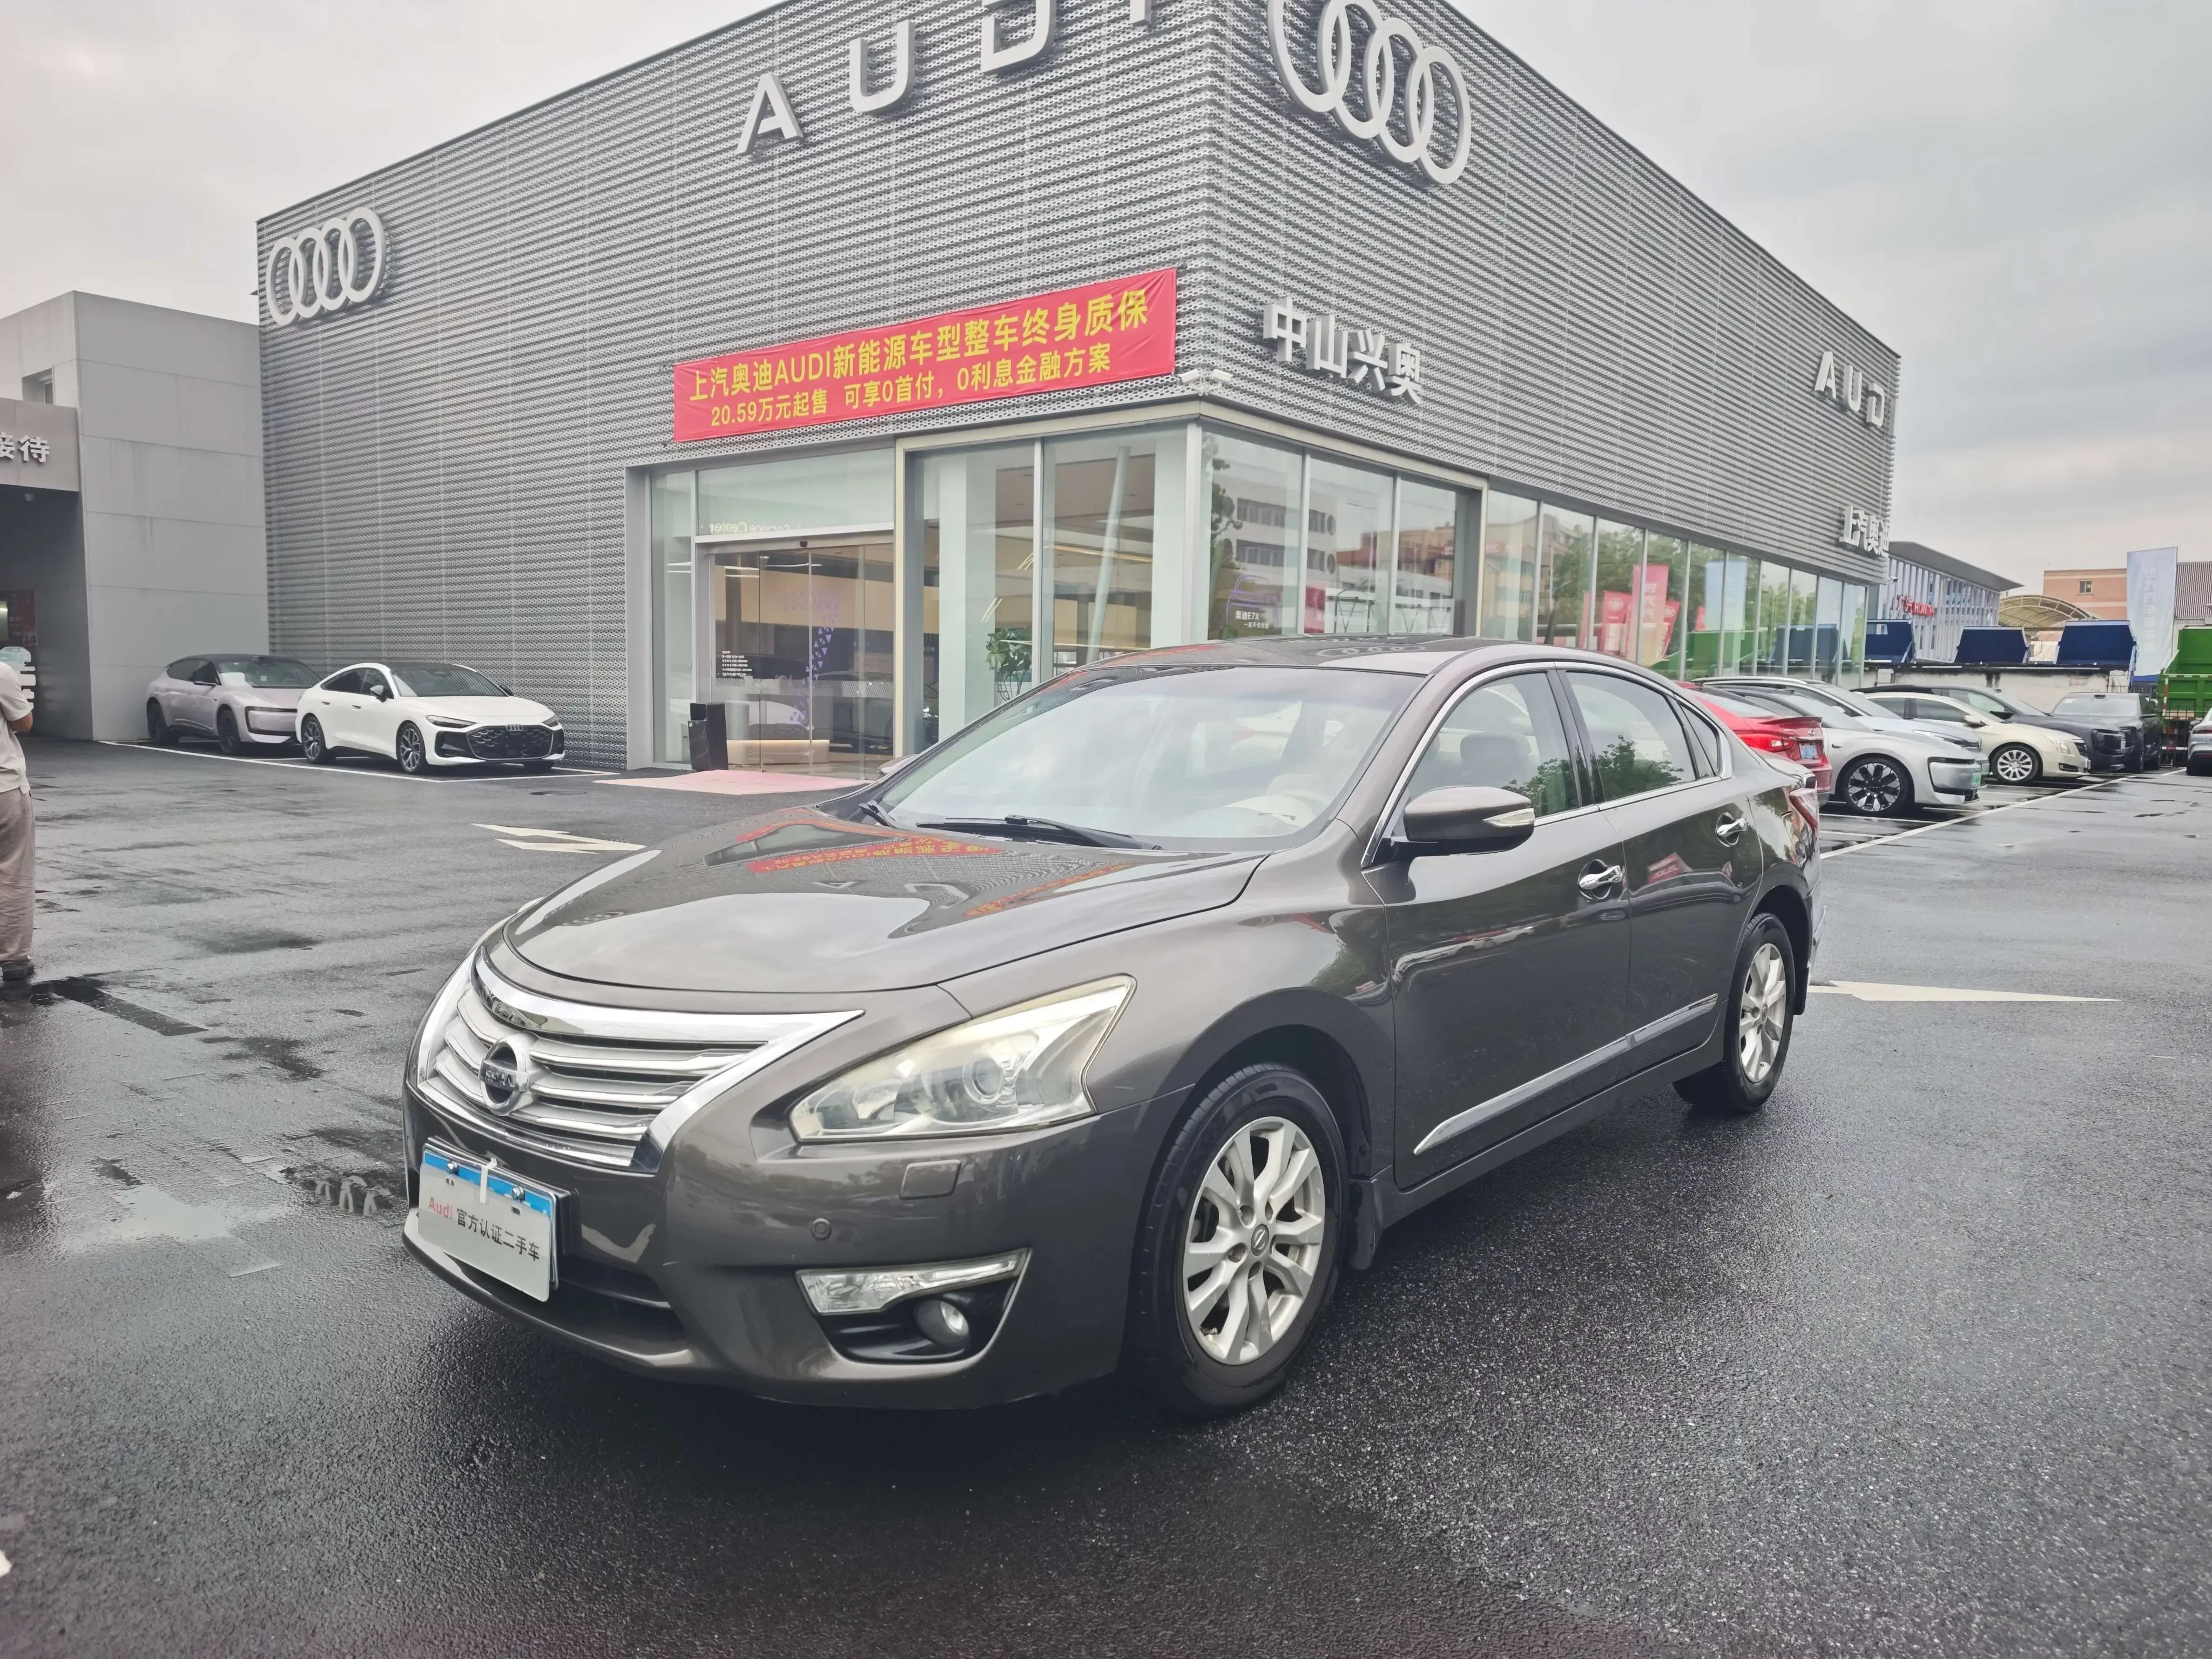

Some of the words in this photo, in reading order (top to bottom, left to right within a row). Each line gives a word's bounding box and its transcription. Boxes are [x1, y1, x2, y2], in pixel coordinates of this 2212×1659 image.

[690, 289, 1148, 401] 上汽奥迪AUDI新能源车型整车终身质保
[1263, 297, 1422, 404] 中山兴奥
[710, 388, 828, 427] 20.59万元起售
[1839, 505, 1890, 558] 上汽奥迪
[1235, 610, 1260, 620] 奥迪E7X
[428, 1196, 453, 1220] Audi
[456, 1208, 539, 1262] 官方认证二手车
